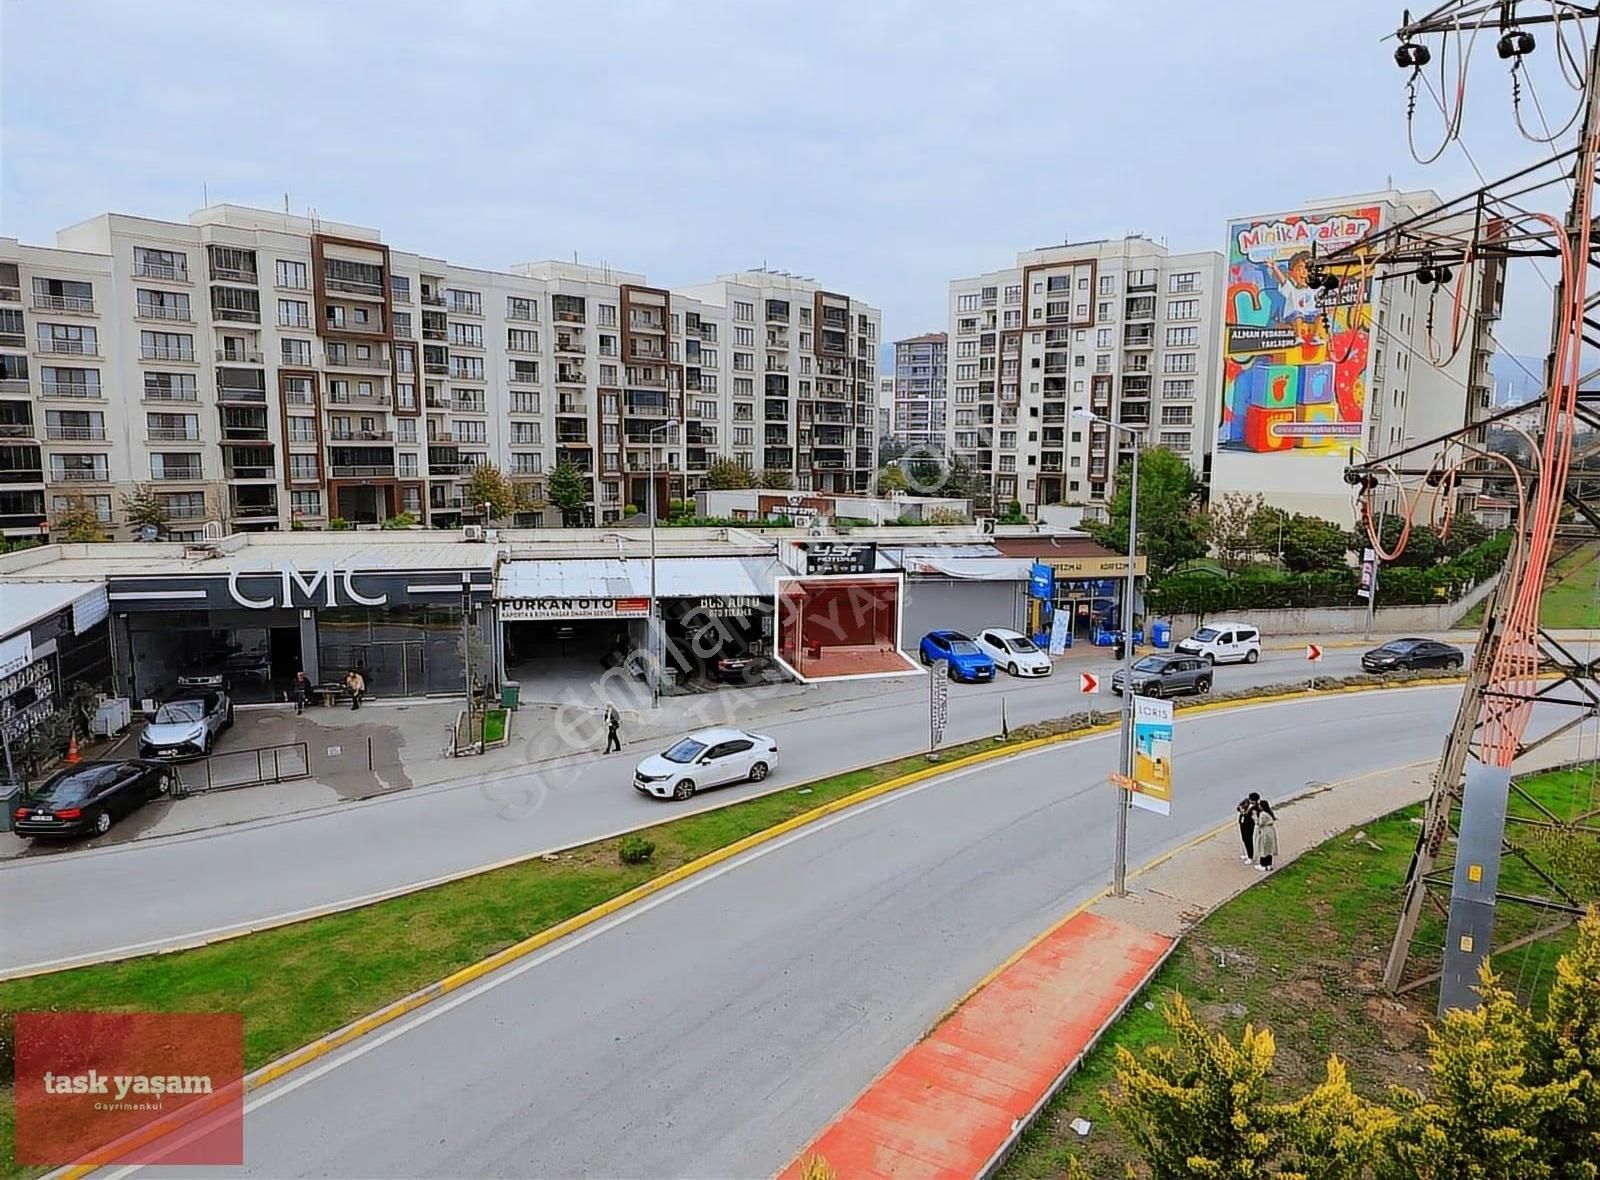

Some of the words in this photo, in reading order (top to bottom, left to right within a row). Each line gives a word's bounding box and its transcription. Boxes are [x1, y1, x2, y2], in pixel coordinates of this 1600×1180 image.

[1242, 226, 1293, 249] Minik
[1295, 219, 1367, 243] Ayaklar
[1231, 330, 1260, 339] ALMAN
[808, 545, 872, 557] YSF
[228, 560, 387, 609] CMC
[501, 599, 573, 611] FURKAN
[578, 599, 614, 609] OTO
[1139, 706, 1168, 719] LORIS
